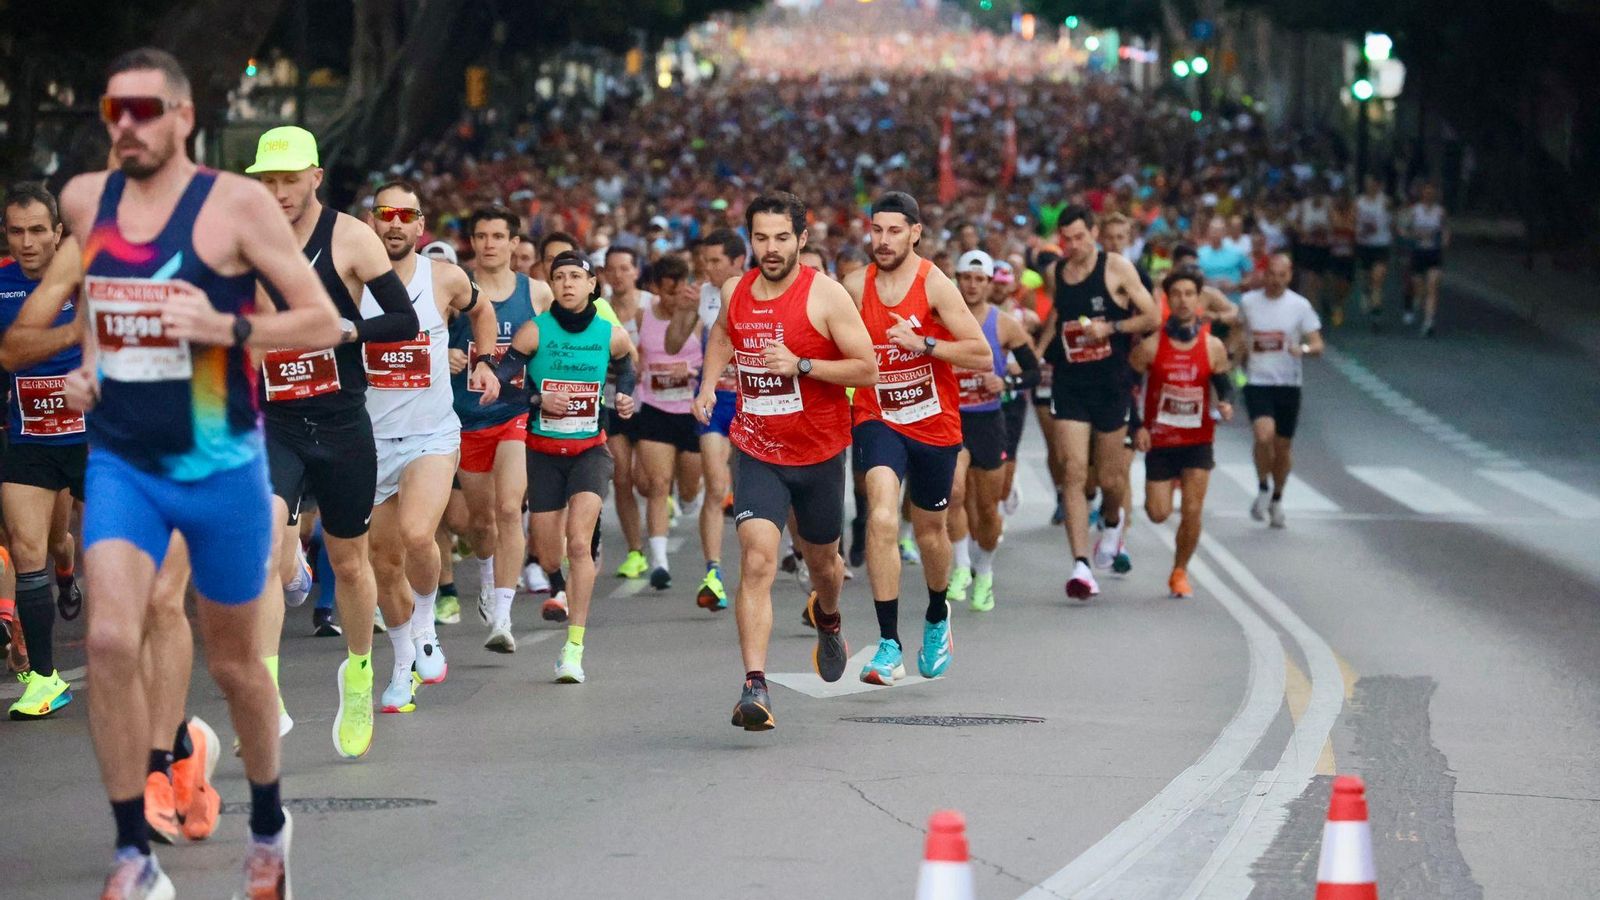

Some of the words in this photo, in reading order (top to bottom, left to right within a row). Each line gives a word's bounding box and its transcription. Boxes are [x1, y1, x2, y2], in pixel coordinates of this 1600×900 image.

[264, 140, 288, 152] ciele
[743, 322, 773, 330] GENERALI
[380, 352, 414, 363] 4835
[279, 360, 314, 377] 2351
[747, 375, 783, 388] 17644
[887, 368, 928, 383] GENERALI
[32, 379, 67, 389] GENERA
[558, 383, 595, 392] GENERALI
[888, 386, 923, 402] 13496
[33, 397, 65, 410] 2412
[567, 400, 588, 411] 534
